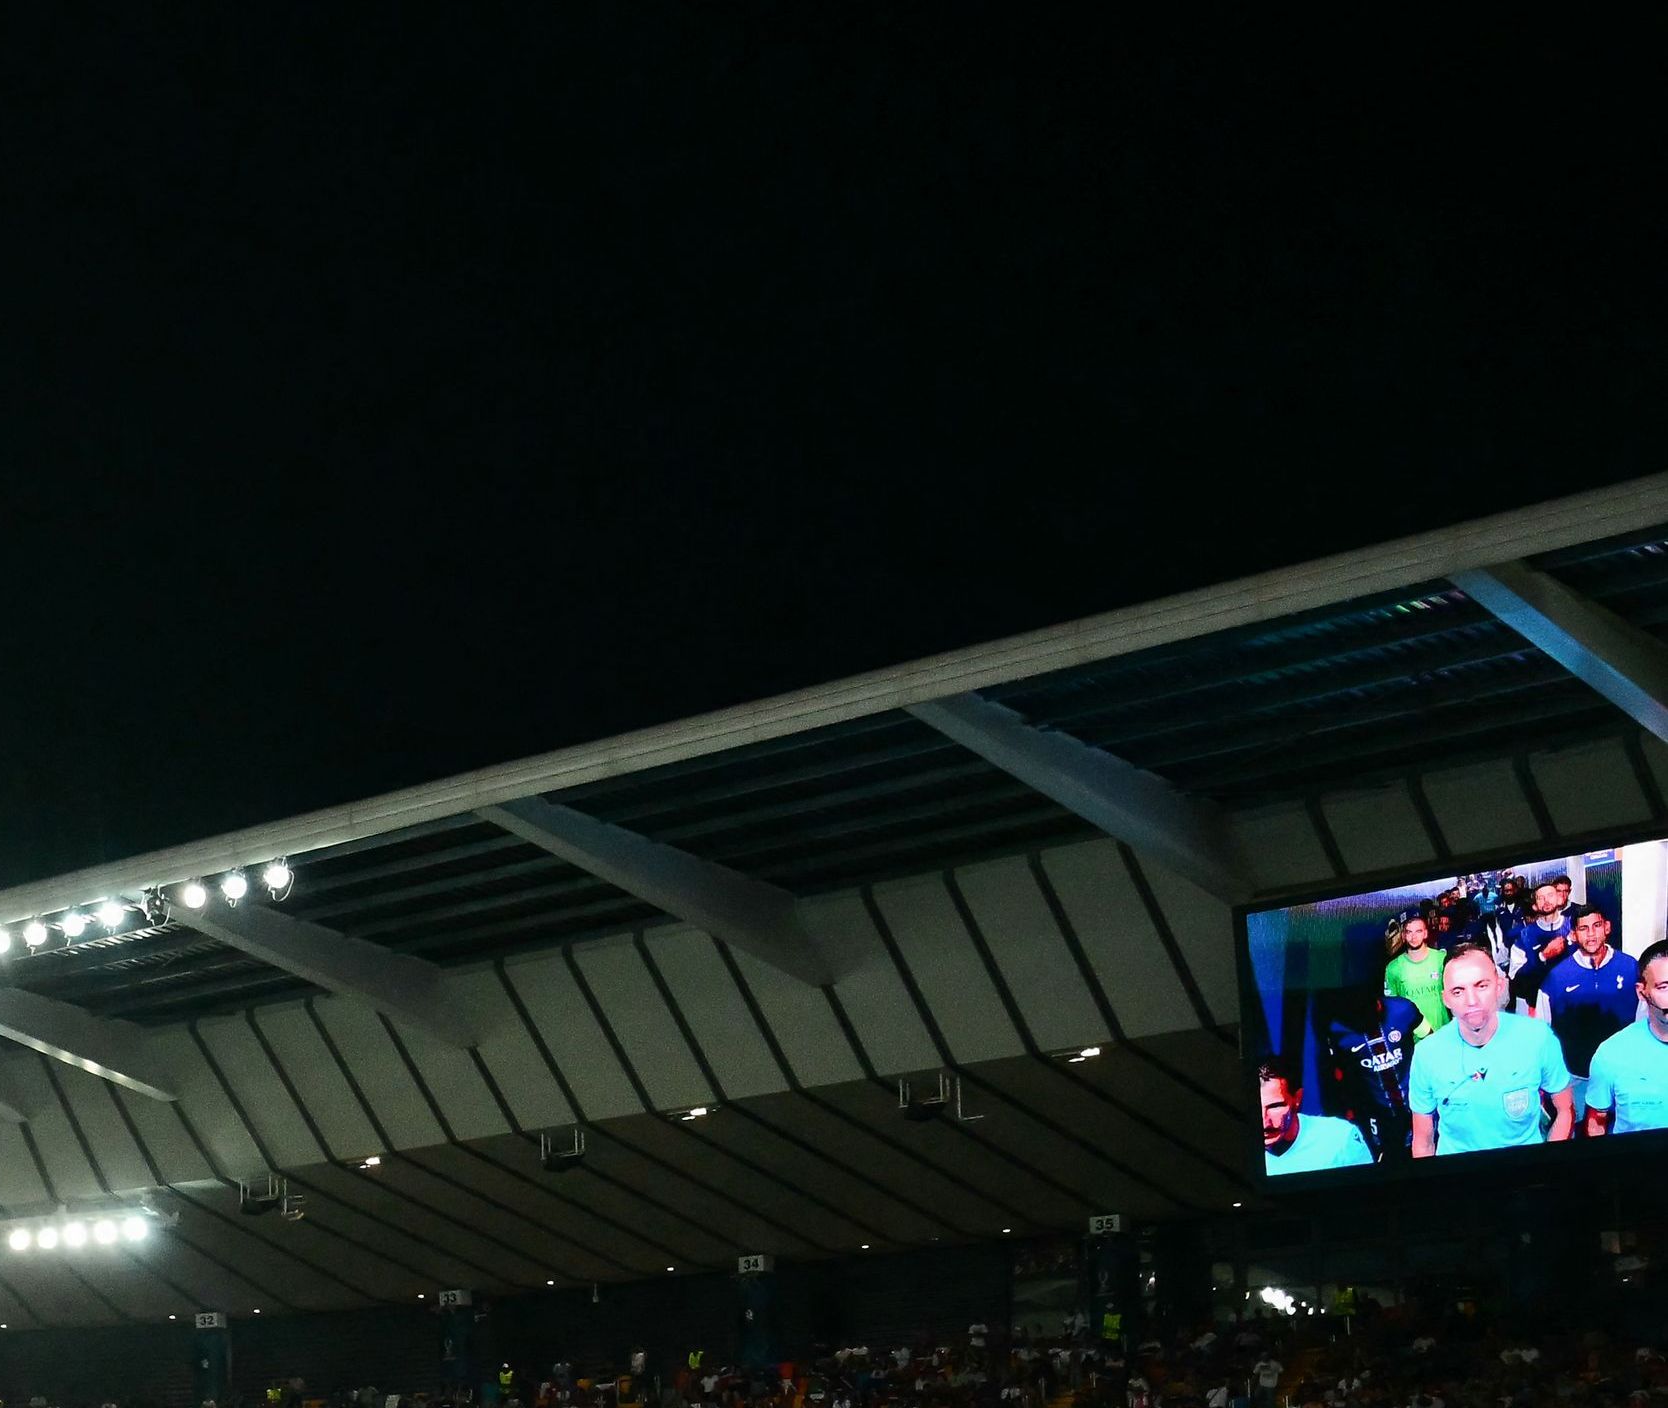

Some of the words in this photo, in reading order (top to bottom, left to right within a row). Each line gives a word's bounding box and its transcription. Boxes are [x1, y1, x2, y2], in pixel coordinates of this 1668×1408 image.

[1360, 1047, 1402, 1069] QATAR
[1369, 1117, 1378, 1136] 5
[1095, 1218, 1114, 1230] 35
[743, 1259, 759, 1270] 34
[200, 1315, 213, 1326] 32
